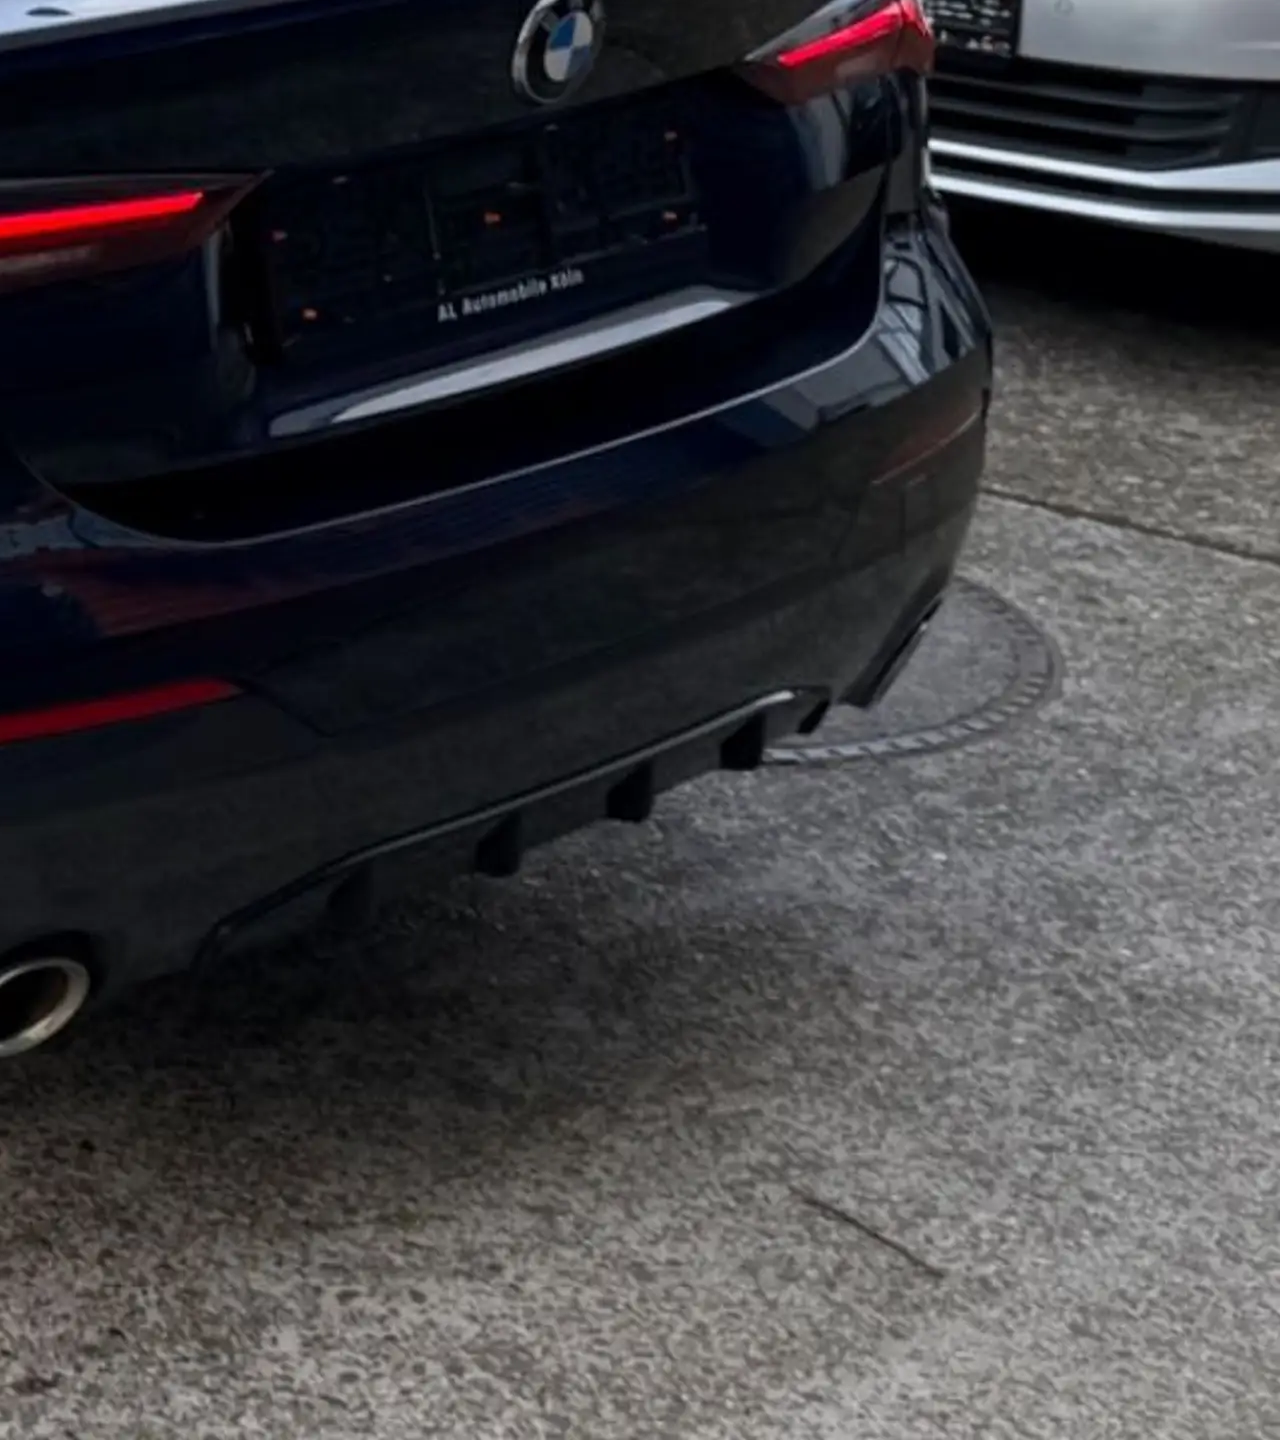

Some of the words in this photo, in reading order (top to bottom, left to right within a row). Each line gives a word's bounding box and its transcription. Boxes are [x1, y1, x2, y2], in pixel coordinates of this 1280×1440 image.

[437, 301, 458, 323] AL
[461, 277, 547, 316] Automobile
[549, 267, 585, 292] Köln
